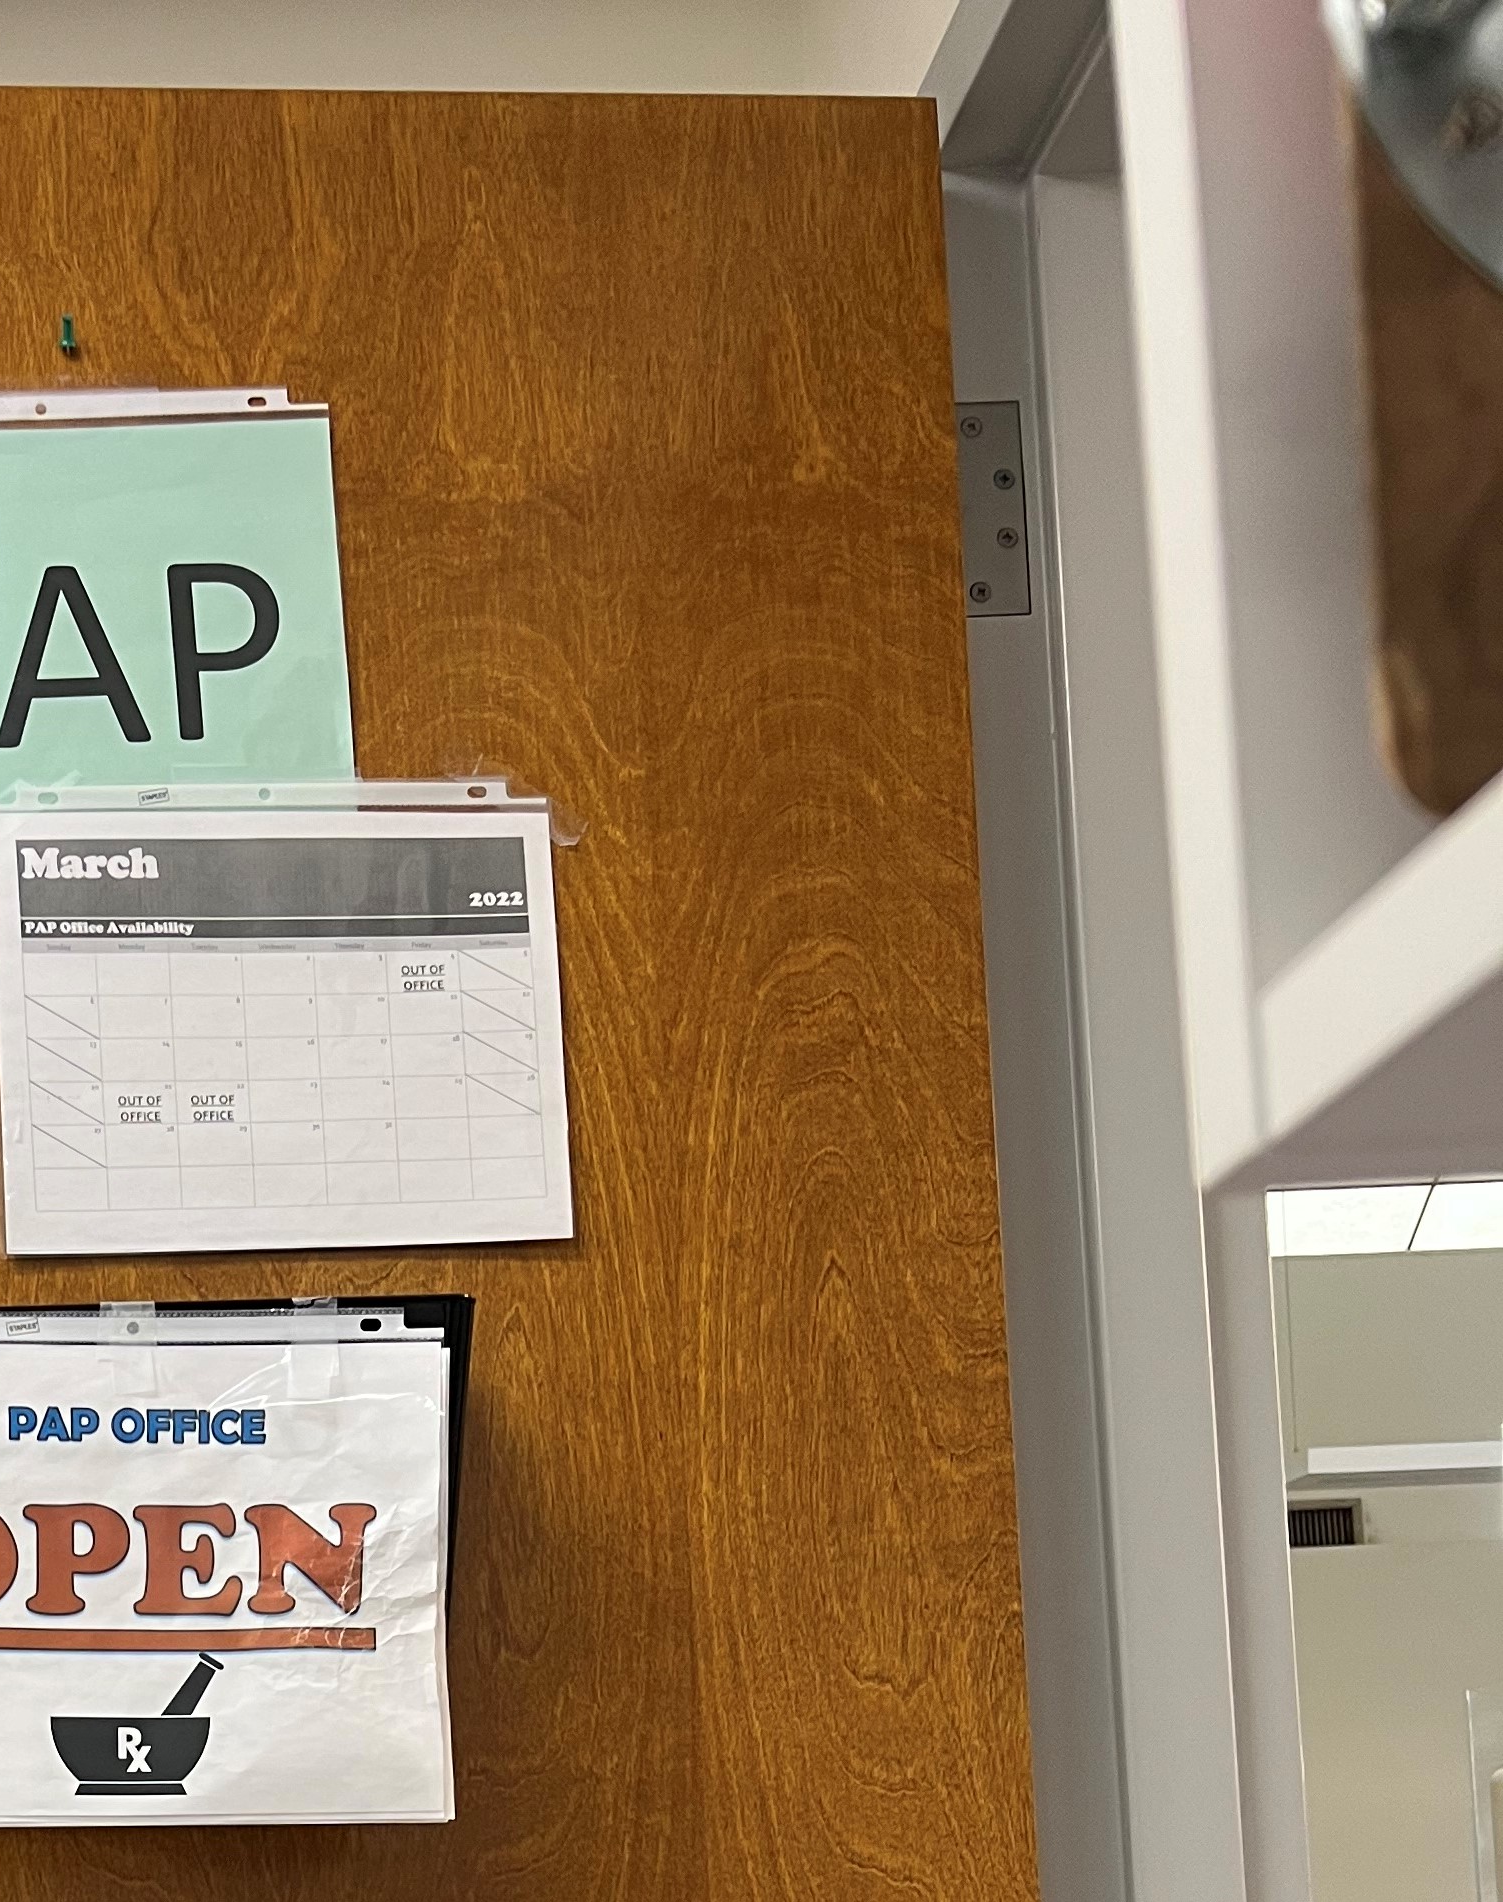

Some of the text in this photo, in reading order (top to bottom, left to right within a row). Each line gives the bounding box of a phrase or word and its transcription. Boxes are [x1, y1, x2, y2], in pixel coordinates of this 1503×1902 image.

[21, 848, 159, 879] March
[469, 892, 523, 907] 2022
[24, 920, 195, 937] PAP Office Availability
[401, 964, 445, 976] OUT OF
[404, 980, 444, 992] OFFICE
[118, 1095, 162, 1106] OUT OF
[190, 1095, 235, 1105] OUT OF
[121, 1112, 161, 1123] OFFICE
[194, 1111, 234, 1123] OFFICE
[8, 1406, 266, 1445] PAP OFFICE
